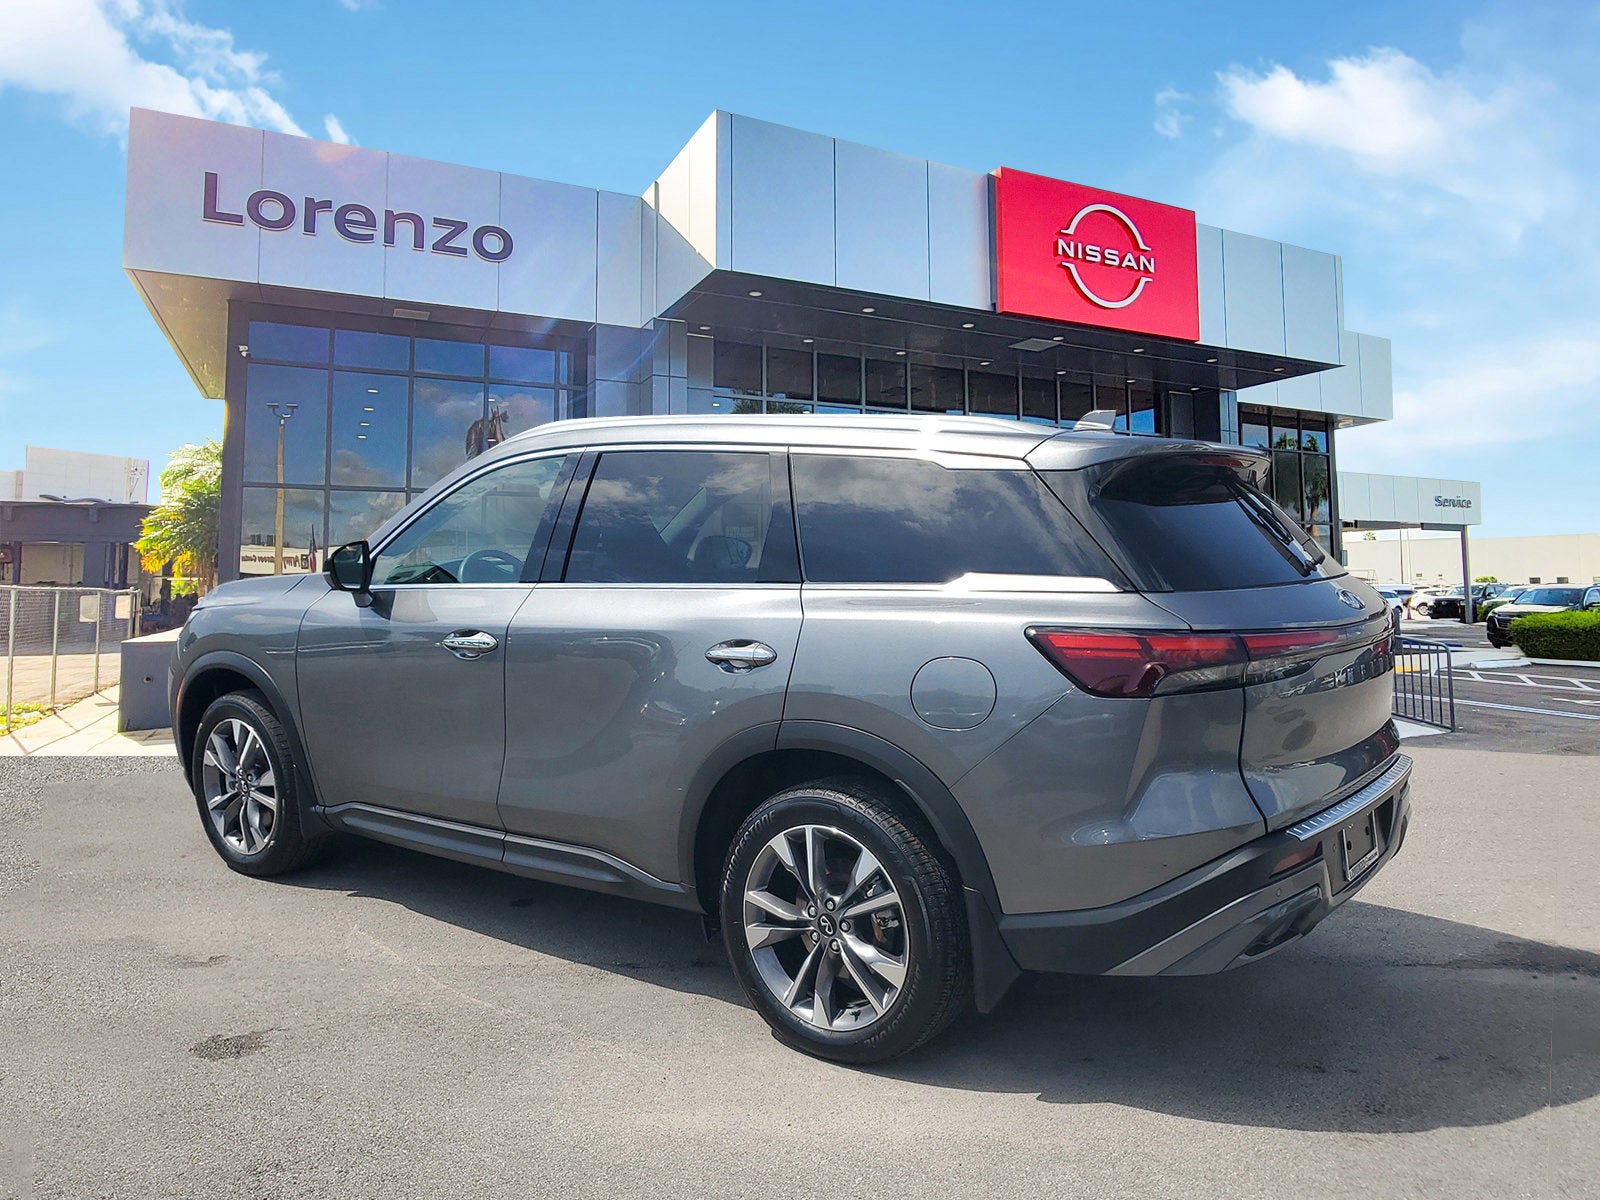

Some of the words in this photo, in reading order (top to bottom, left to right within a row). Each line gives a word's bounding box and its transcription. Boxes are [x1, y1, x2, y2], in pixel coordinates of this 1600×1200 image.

[202, 171, 514, 263] Lorenzo
[1057, 238, 1155, 273] NISSAN
[1434, 495, 1472, 508] Service
